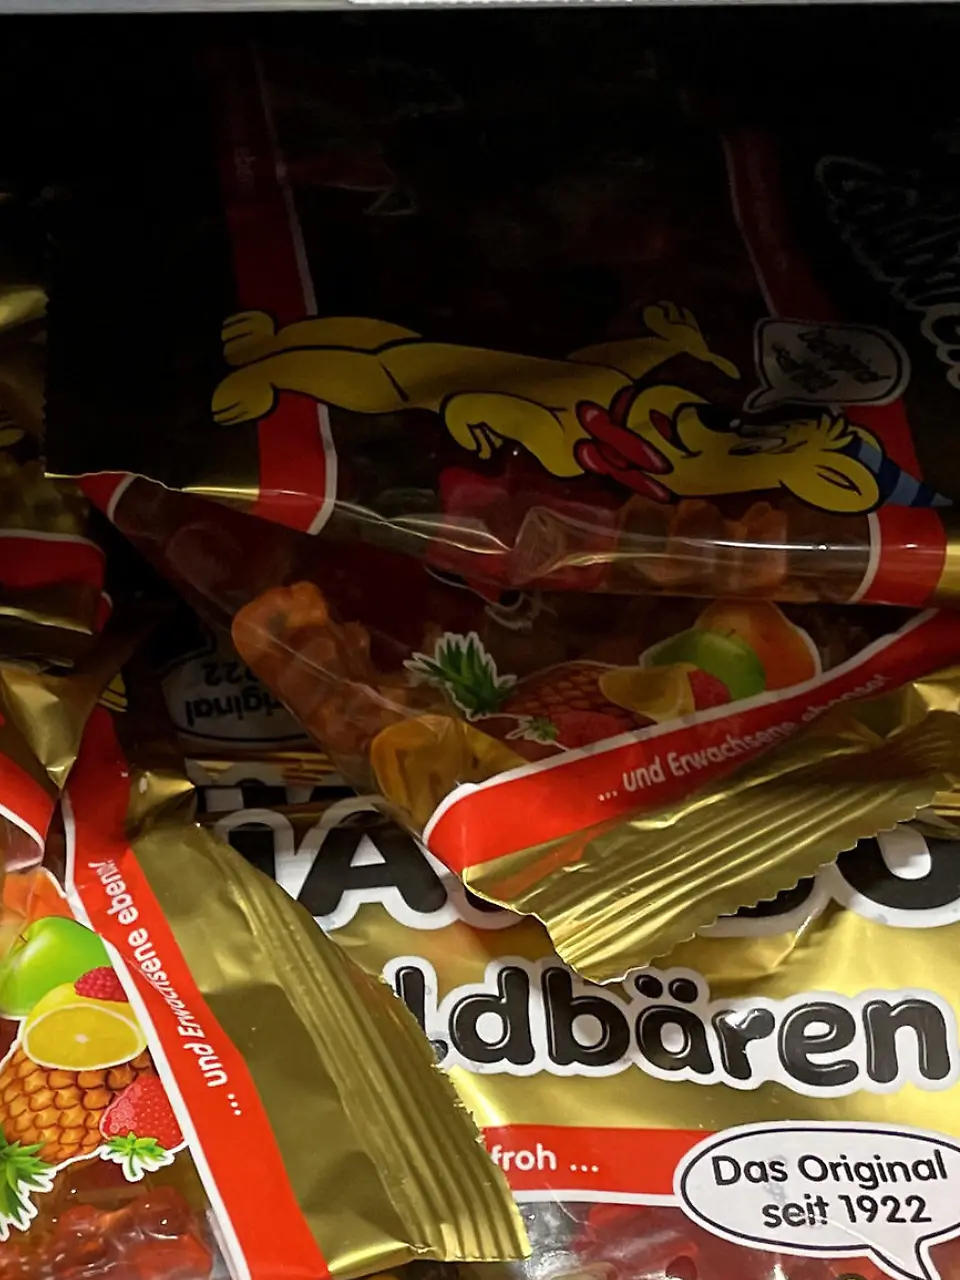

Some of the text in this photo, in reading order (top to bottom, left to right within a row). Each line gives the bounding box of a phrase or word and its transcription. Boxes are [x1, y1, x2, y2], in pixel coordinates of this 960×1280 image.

[621, 754, 668, 792] und
[668, 720, 802, 777] Erwachsene
[394, 963, 953, 1088] ldbären
[182, 1041, 229, 1088] und
[491, 1142, 557, 1172] froh
[711, 1148, 949, 1191] Das Original
[761, 1193, 933, 1229] seit 1922
